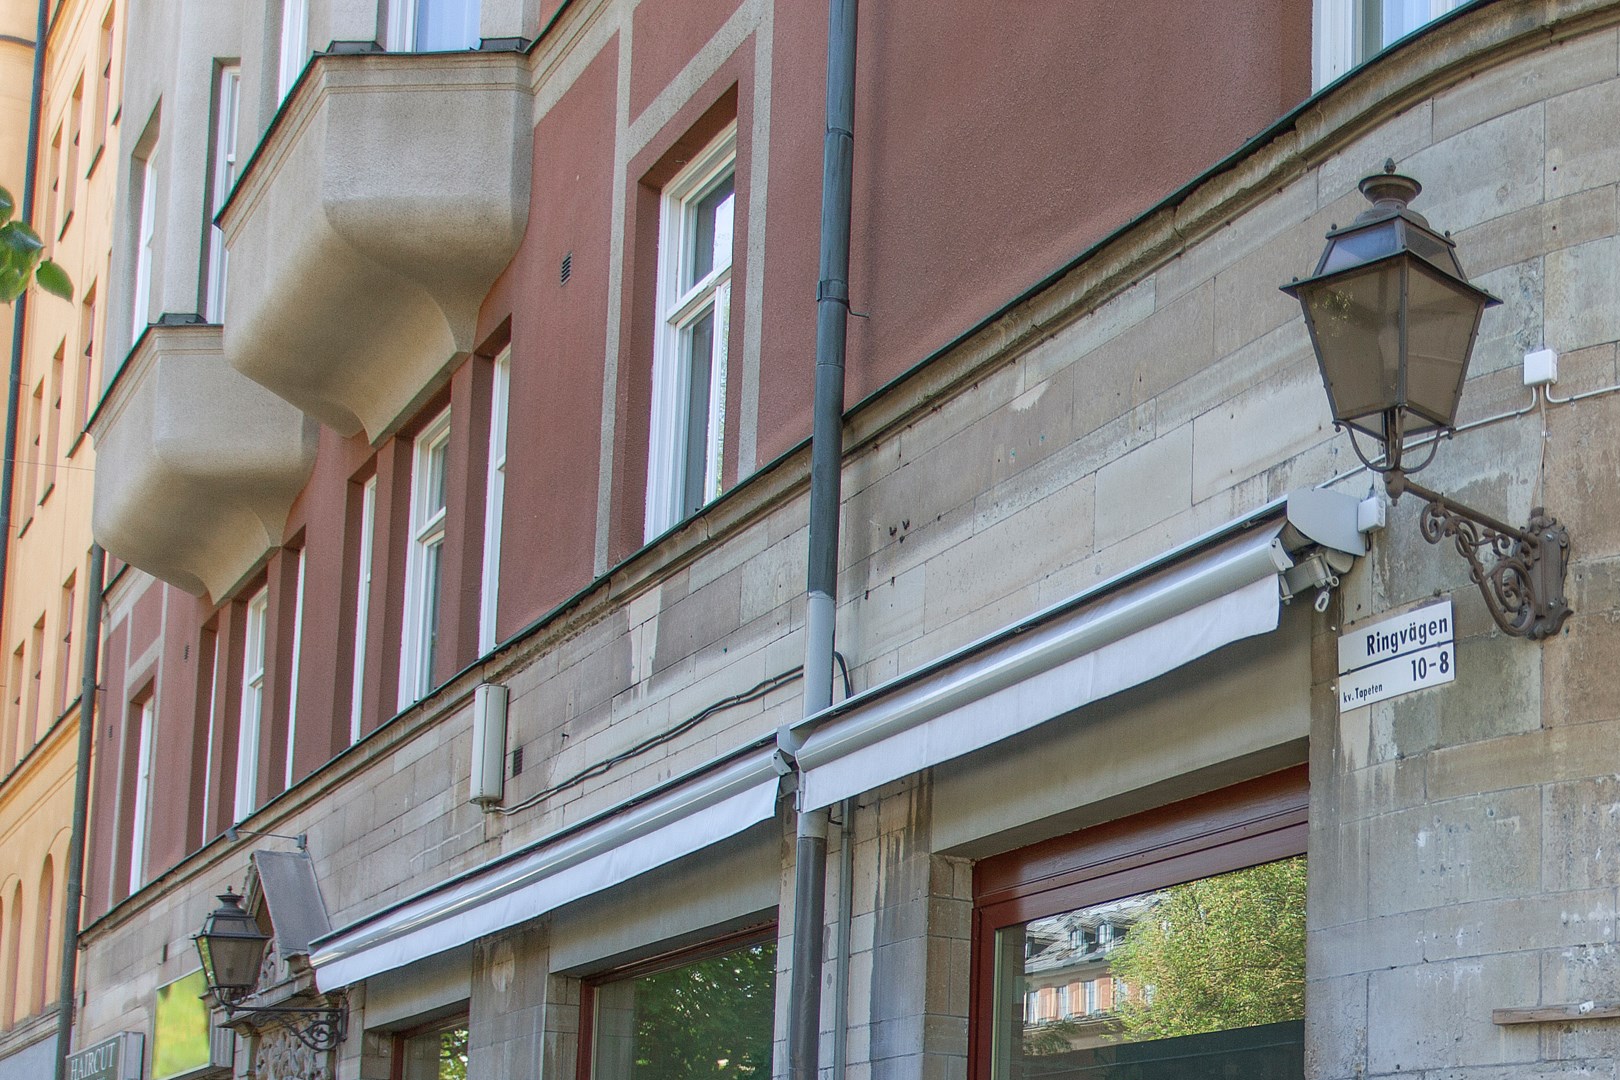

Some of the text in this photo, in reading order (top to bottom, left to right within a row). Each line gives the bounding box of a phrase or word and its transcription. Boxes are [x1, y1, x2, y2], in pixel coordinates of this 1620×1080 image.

[1366, 617, 1448, 656] Ringvägen
[1411, 651, 1449, 682] 10-8
[1343, 683, 1383, 703] kv. Tapeten
